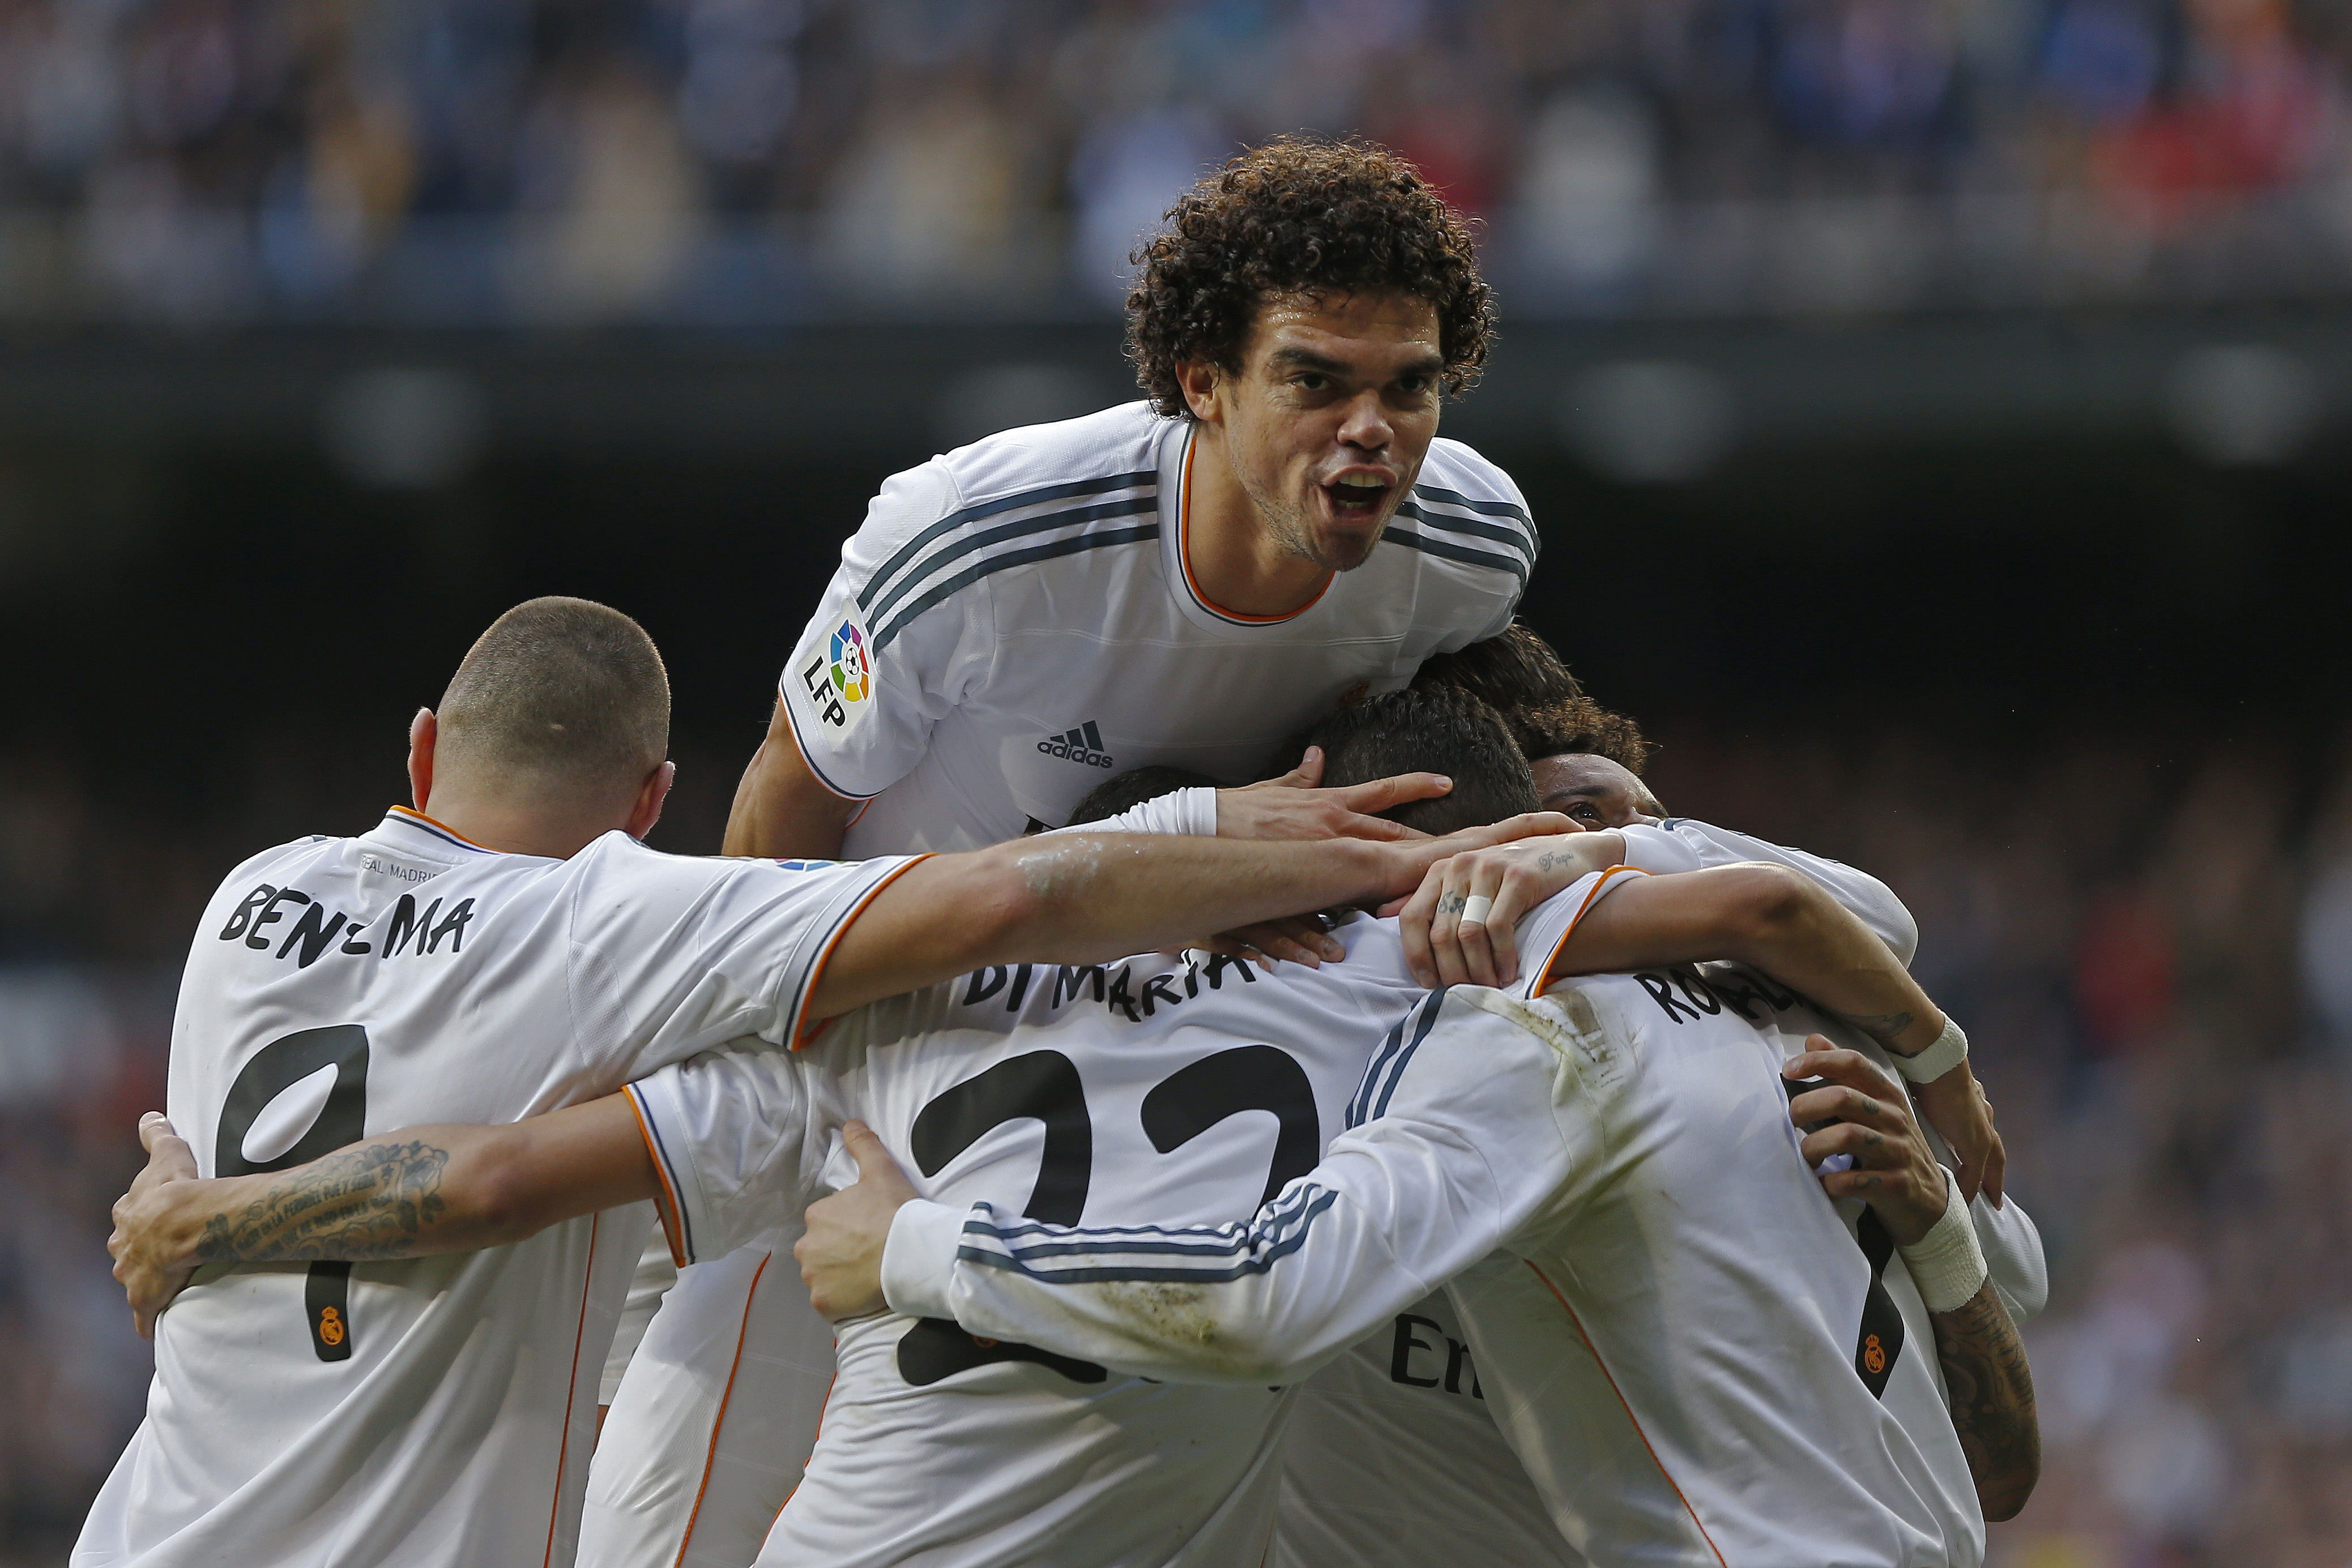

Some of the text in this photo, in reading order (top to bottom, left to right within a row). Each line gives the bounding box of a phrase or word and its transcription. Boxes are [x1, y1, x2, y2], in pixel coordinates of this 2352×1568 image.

[803, 655, 846, 727] LFP
[1037, 741, 1113, 769] adidas
[963, 963, 1032, 1012] DI
[215, 1024, 369, 1362] 9
